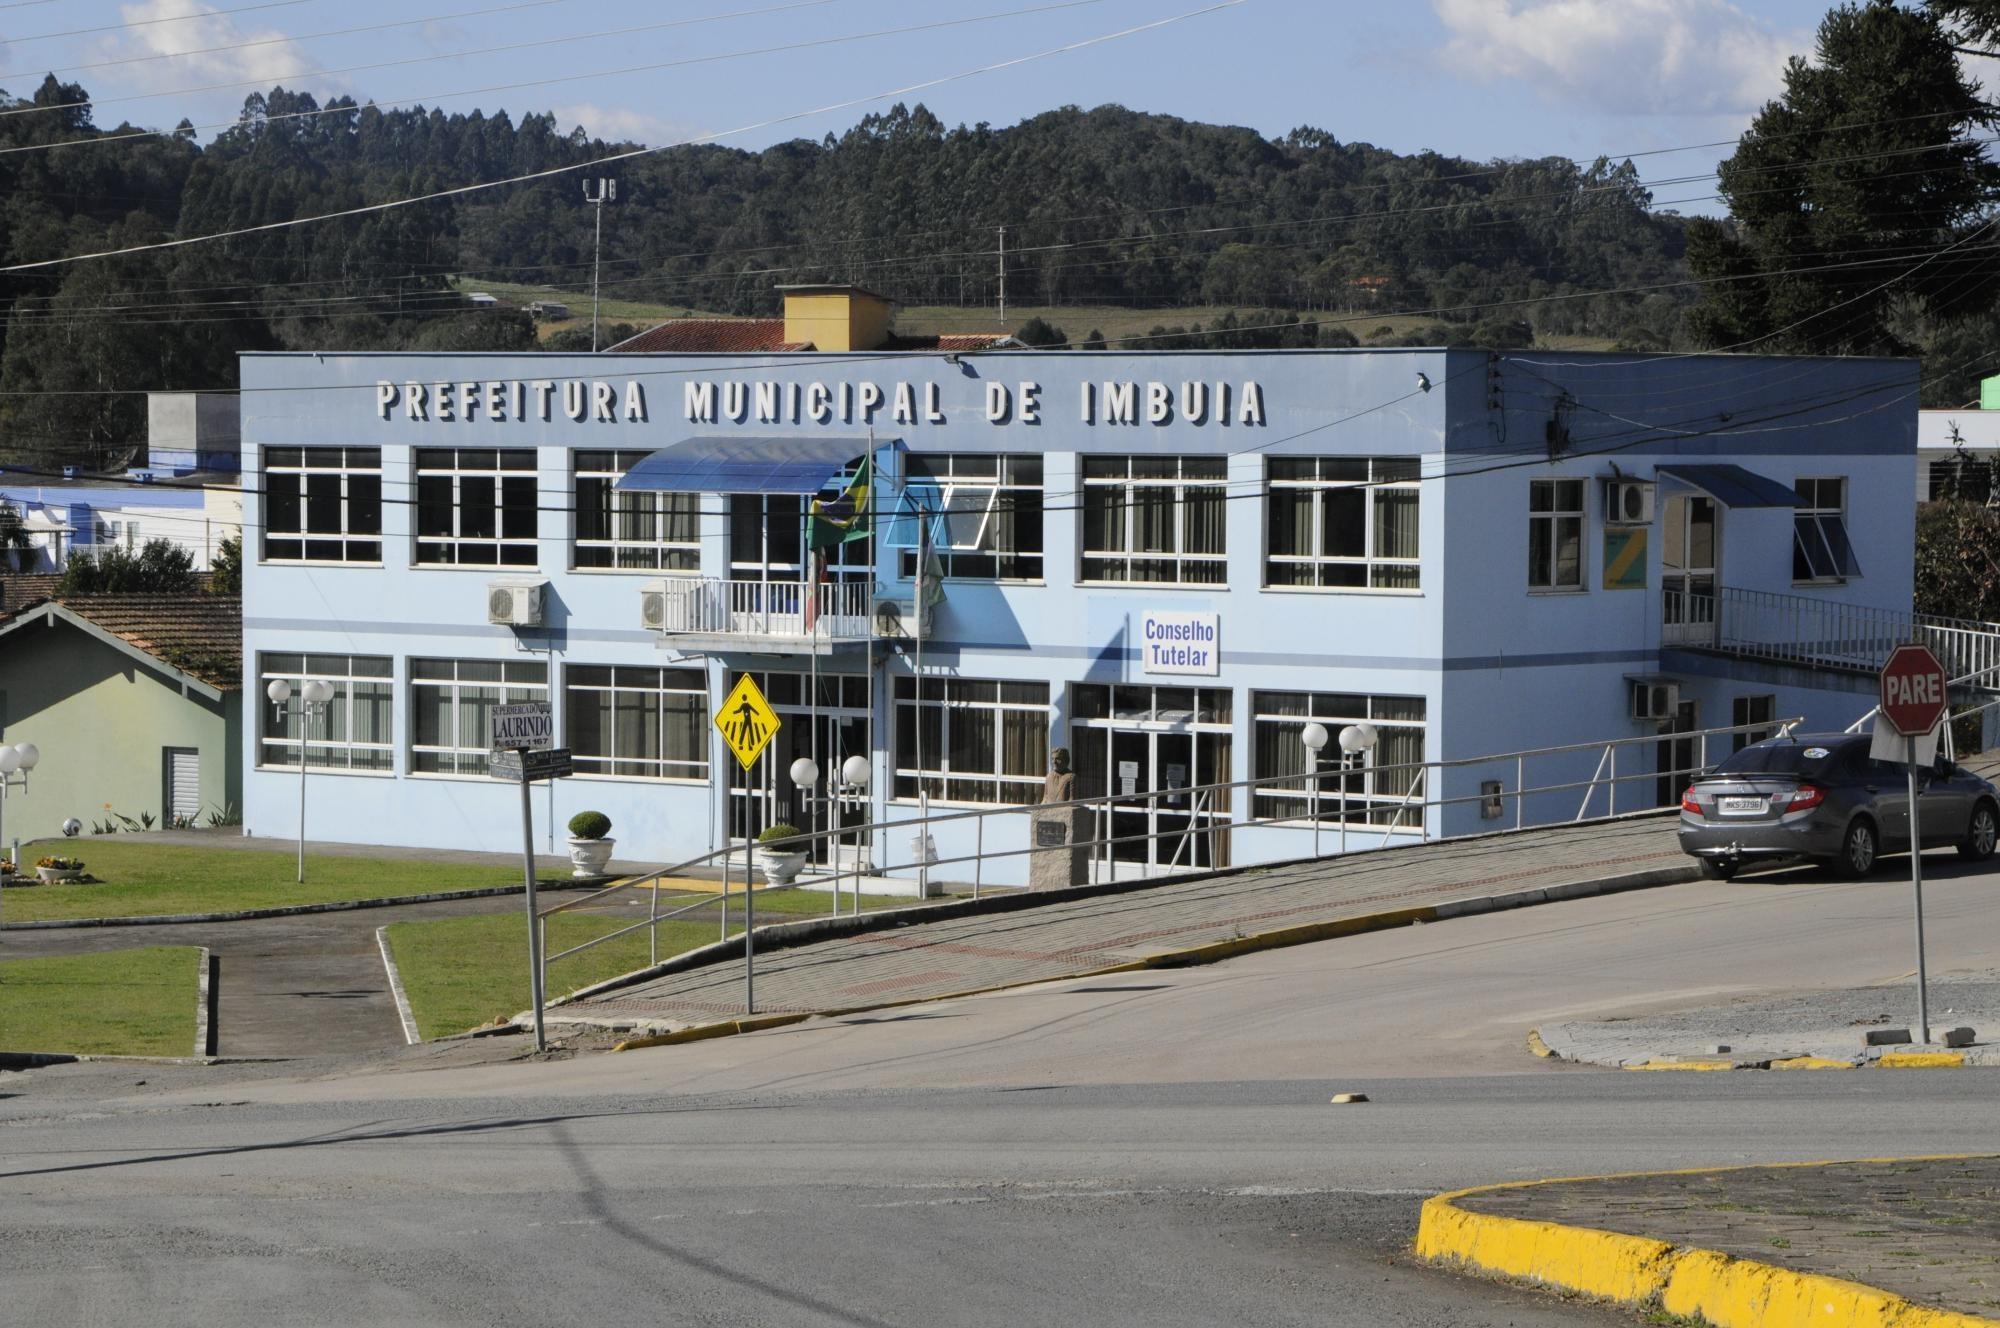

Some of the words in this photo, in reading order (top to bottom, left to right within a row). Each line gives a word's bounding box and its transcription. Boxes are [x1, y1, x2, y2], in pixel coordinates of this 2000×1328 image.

[376, 380, 646, 421] PREFEITURA
[685, 381, 942, 421] MUNICIPAL
[986, 382, 1039, 422] DE
[1081, 381, 1264, 423] IMBUIA
[1145, 618, 1214, 641] Conselho
[1151, 644, 1208, 666] Tutelar
[1886, 673, 1941, 706] PARE
[493, 715, 553, 738] LAURINDO
